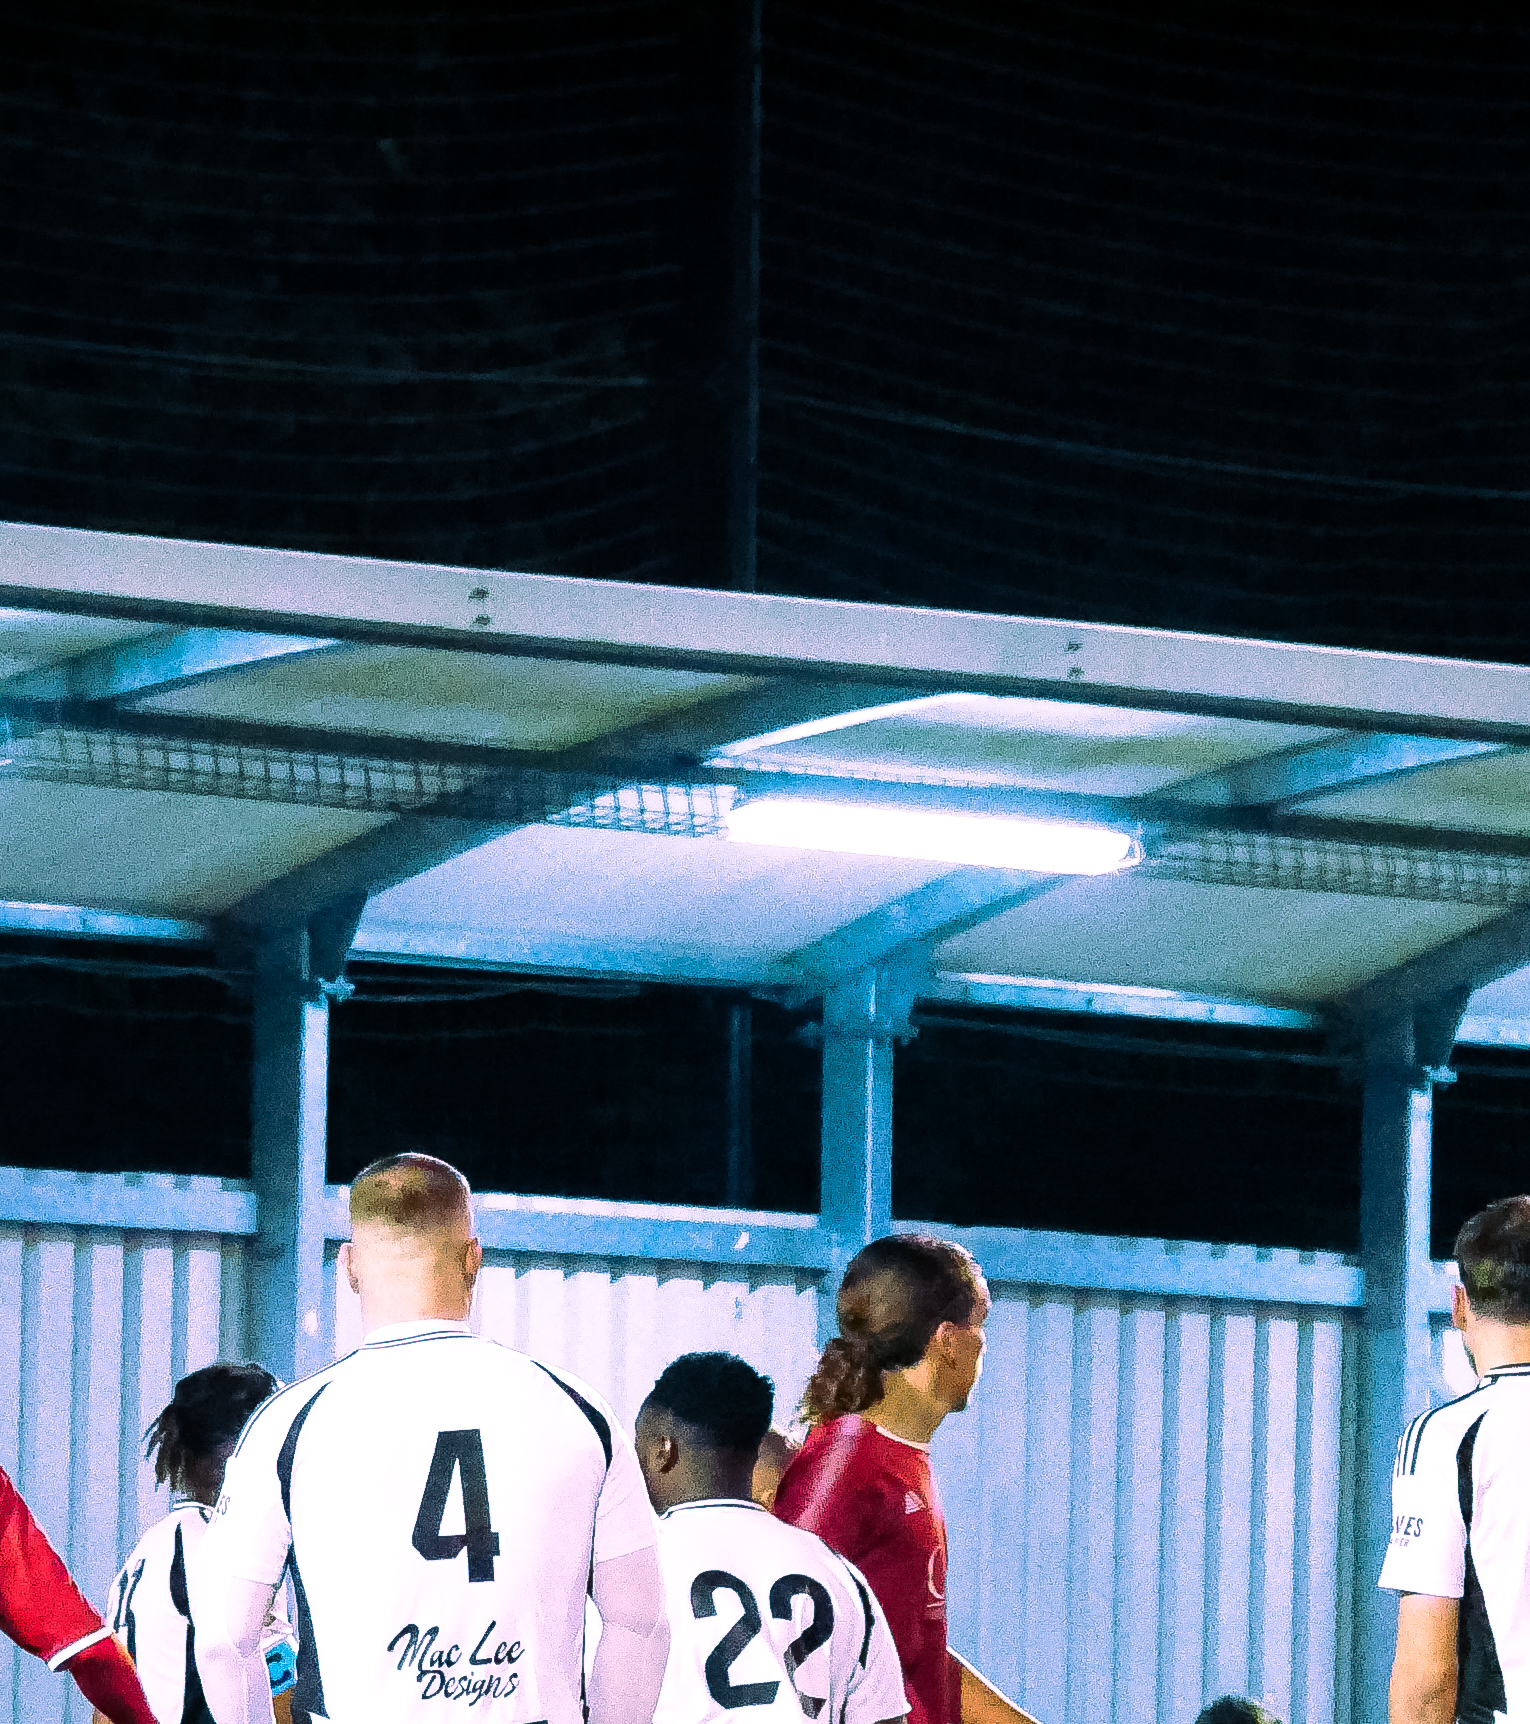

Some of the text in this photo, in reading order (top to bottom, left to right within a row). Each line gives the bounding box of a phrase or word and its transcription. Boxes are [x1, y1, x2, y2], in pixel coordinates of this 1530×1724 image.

[411, 1428, 500, 1582] 4
[387, 1620, 526, 1673] Mac Lee
[416, 1668, 521, 1707] Designs
[690, 1569, 835, 1720] 22
